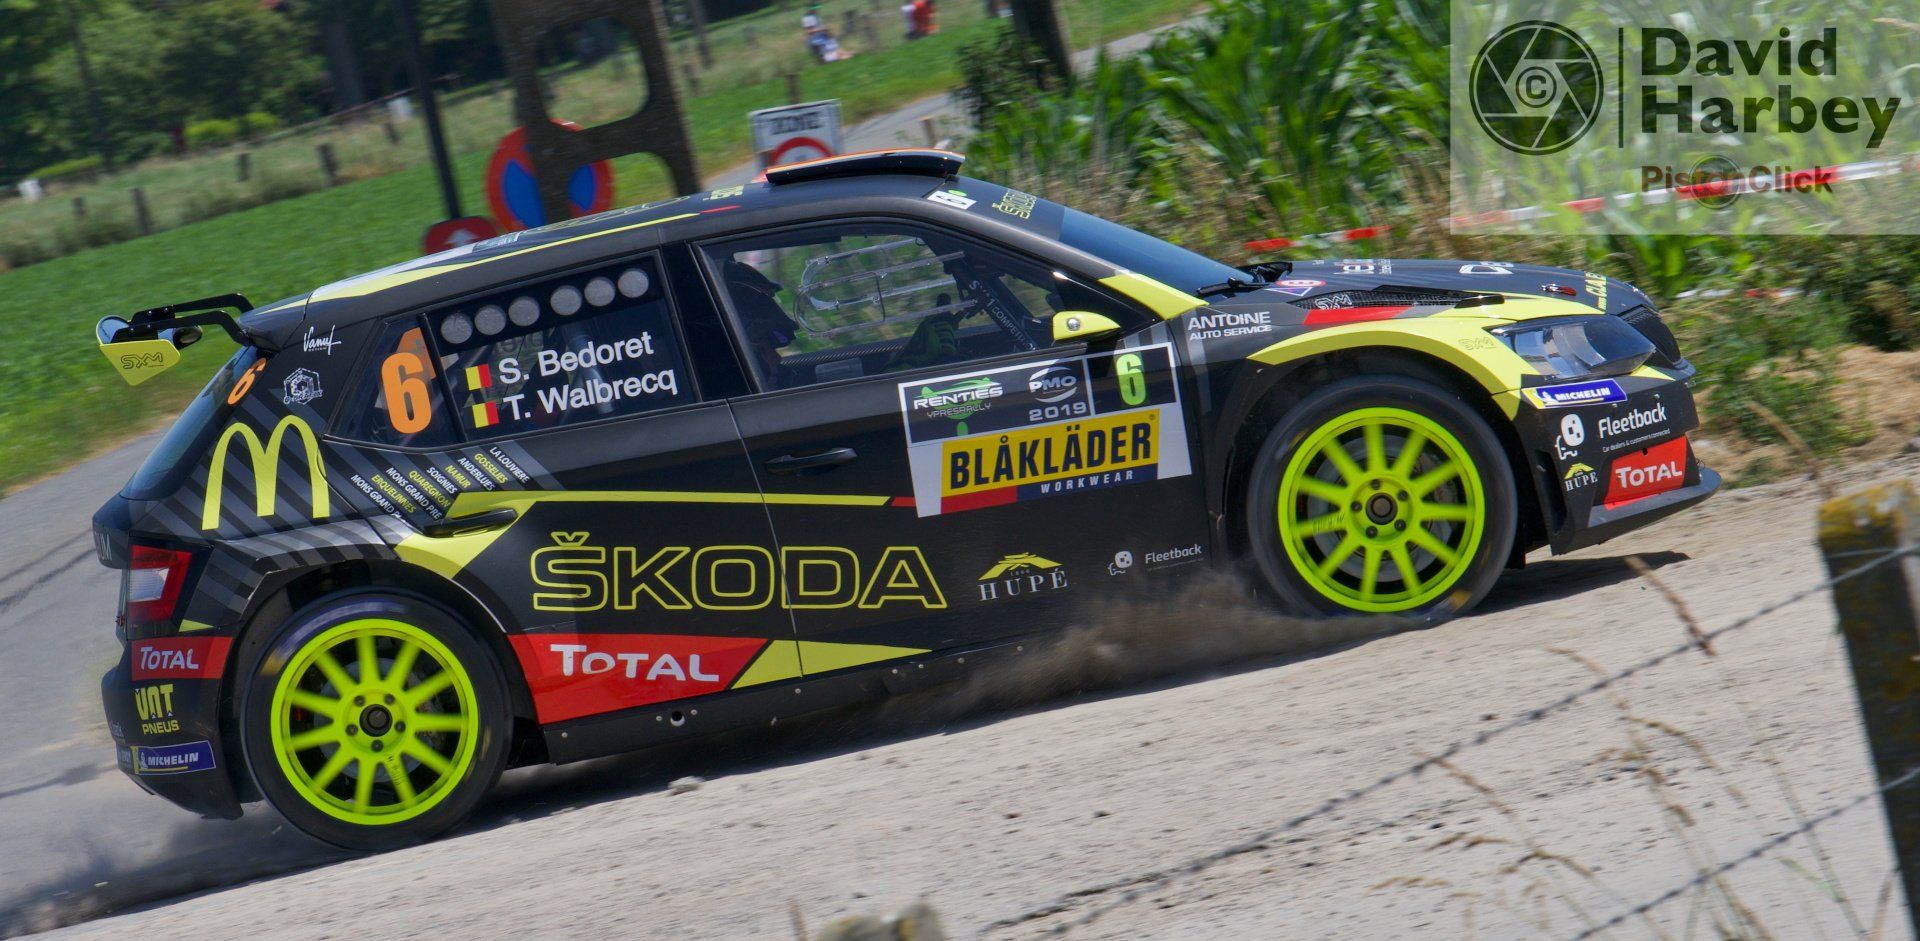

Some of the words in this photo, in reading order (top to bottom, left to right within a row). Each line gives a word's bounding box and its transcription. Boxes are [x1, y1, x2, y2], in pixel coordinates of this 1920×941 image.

[1188, 311, 1271, 330] ANTOINE
[1190, 330, 1221, 341] AUTO
[1223, 324, 1273, 337] SERVICE
[499, 358, 530, 385] S.
[537, 331, 655, 377] Bedoret
[227, 357, 267, 406] 6
[381, 351, 433, 434] 6
[503, 393, 532, 421] T.
[537, 369, 678, 415] Walbrecq
[1028, 375, 1077, 392] PMO
[1115, 353, 1148, 406] 6
[1554, 387, 1611, 401] MICHELIN
[913, 385, 1004, 410] RENTIES
[926, 402, 992, 419] YPRESRALLY
[1028, 401, 1087, 421] 2019
[1598, 402, 1667, 438] Fleetback
[474, 453, 509, 484] GOSSELIES
[489, 447, 502, 460] LA
[497, 453, 531, 484] LOUVIERE
[950, 422, 1152, 490] BLÅKLÄDER
[408, 470, 450, 508] QUAREGNON
[426, 467, 458, 494] SOIGNIES
[445, 465, 471, 488] NAMUR
[457, 458, 495, 491] ANDERLUES
[1040, 470, 1134, 494] WORKWEAR
[1615, 461, 1683, 489] TOTAL
[351, 474, 372, 494] MONS
[369, 491, 394, 514] GRAND
[371, 475, 417, 514] ERQUELINNES
[386, 467, 406, 487] MONS
[404, 483, 430, 507] GRAND
[426, 504, 443, 520] PRE
[1145, 544, 1202, 564] Fleetback
[530, 532, 947, 611] ŠKODA
[977, 567, 1068, 601] HUPÉ
[140, 646, 199, 670] TOTAL
[550, 643, 720, 682] TOTAL
[142, 719, 180, 735] PNEUS
[147, 752, 199, 766] MICHELIN
